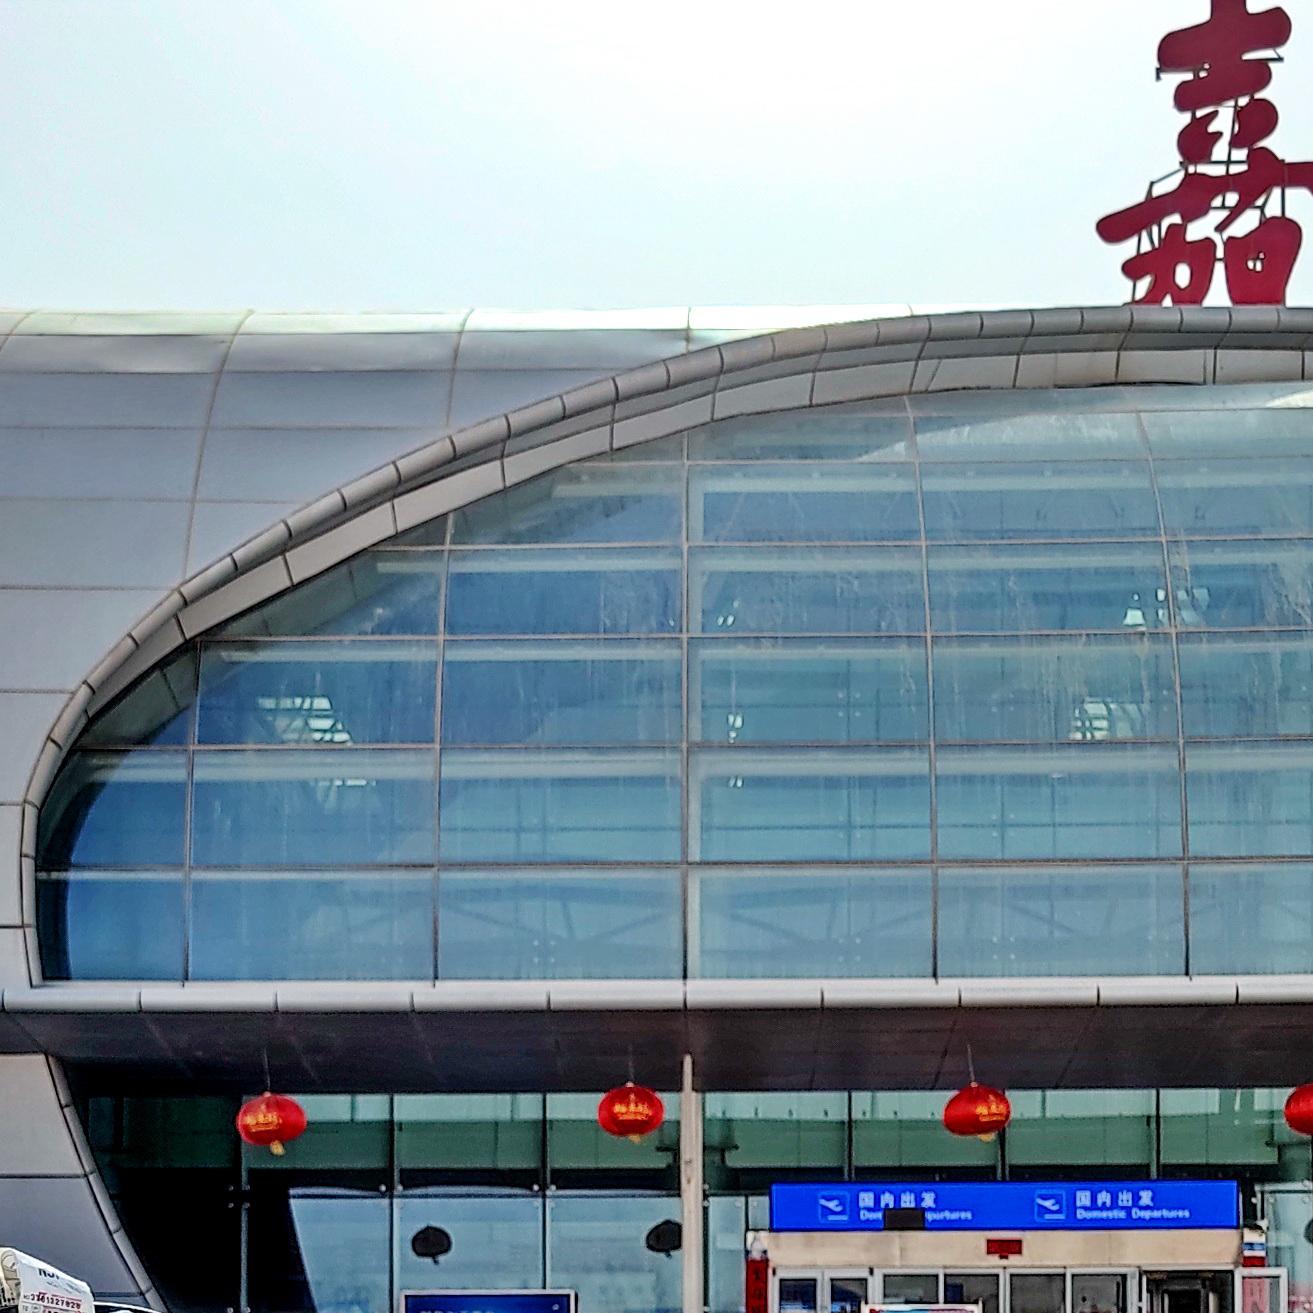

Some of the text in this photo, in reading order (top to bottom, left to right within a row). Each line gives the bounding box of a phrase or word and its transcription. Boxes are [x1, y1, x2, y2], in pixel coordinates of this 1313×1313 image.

[859, 1191, 936, 1208] 国内出发
[1075, 1190, 1154, 1207] 国内出发
[924, 1210, 973, 1222] partures
[1076, 1208, 1191, 1221] Domestic Departures
